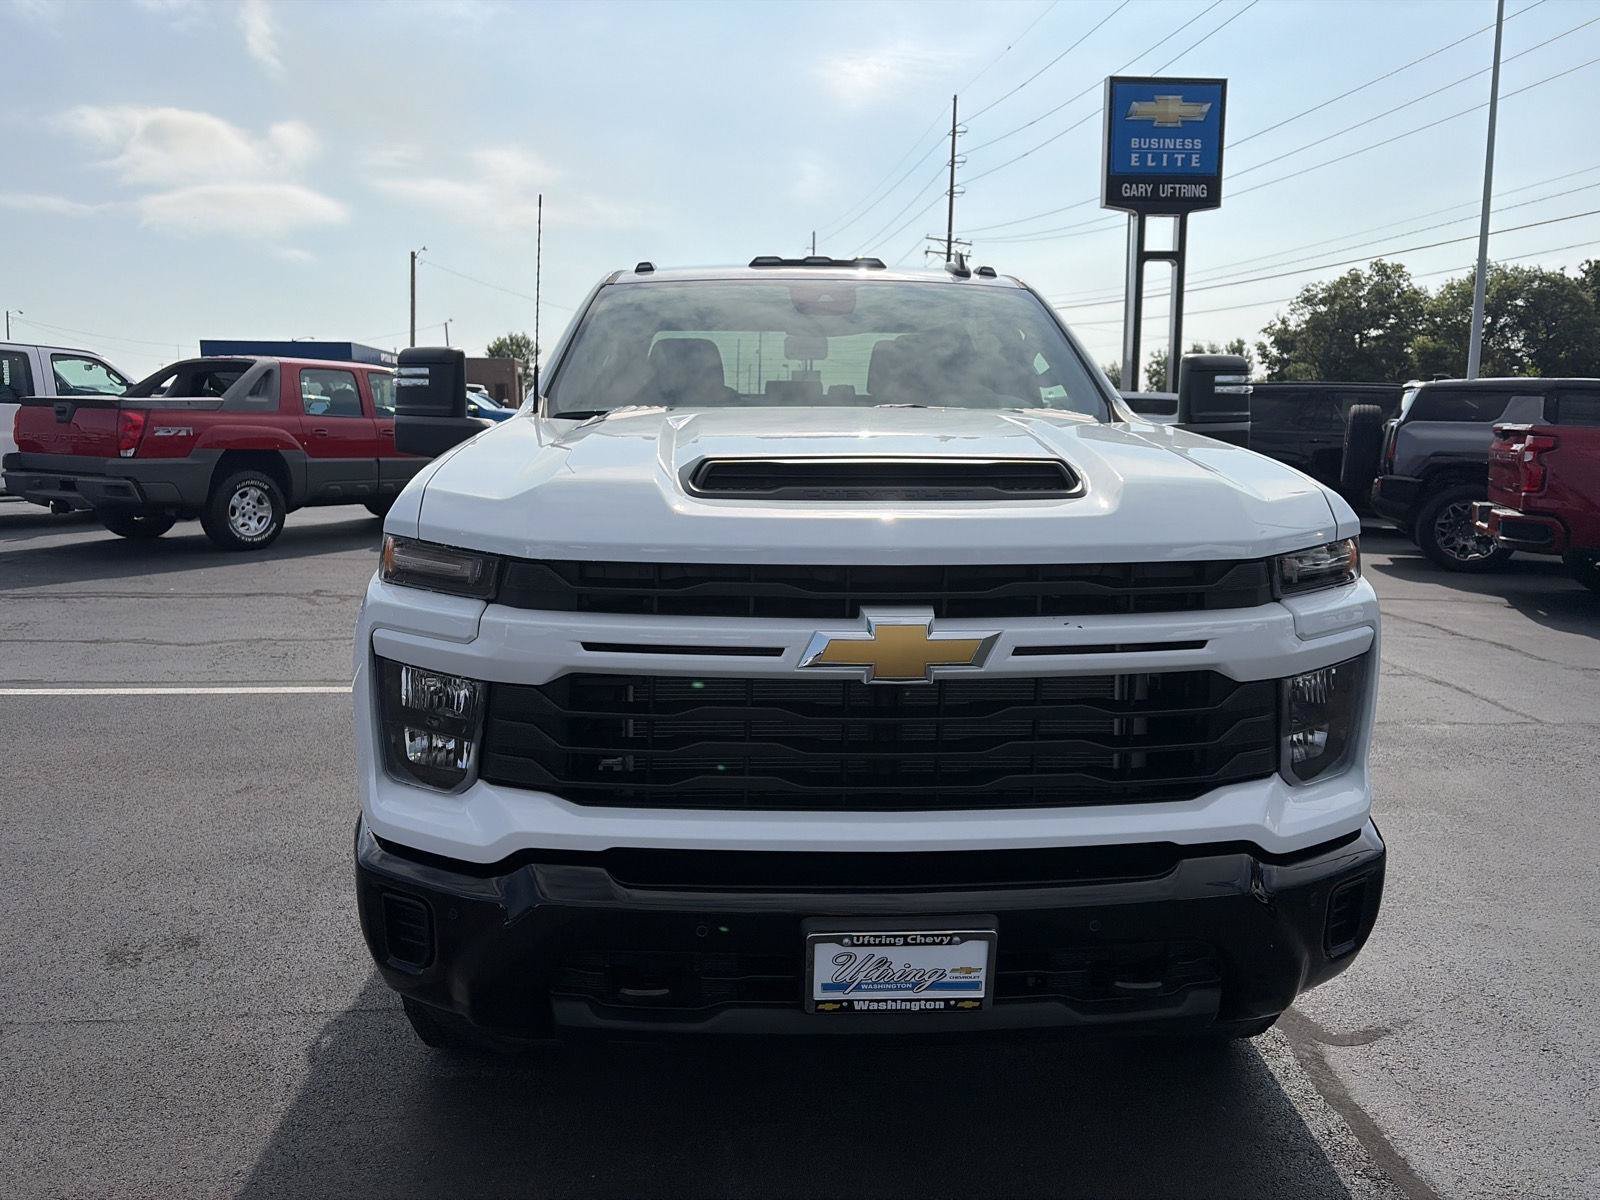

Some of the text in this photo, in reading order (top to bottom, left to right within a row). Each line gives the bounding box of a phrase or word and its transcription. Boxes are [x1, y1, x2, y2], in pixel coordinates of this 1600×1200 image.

[1131, 138, 1202, 149] BUSINESS
[1130, 153, 1201, 167] ELITE
[1122, 183, 1208, 198] GARY UFTRING
[153, 426, 194, 437] Z71
[803, 488, 974, 498] CHEVROLET
[852, 934, 951, 946] Uftring Chevy
[831, 951, 947, 995] Uftring
[853, 1000, 945, 1011] Washington
